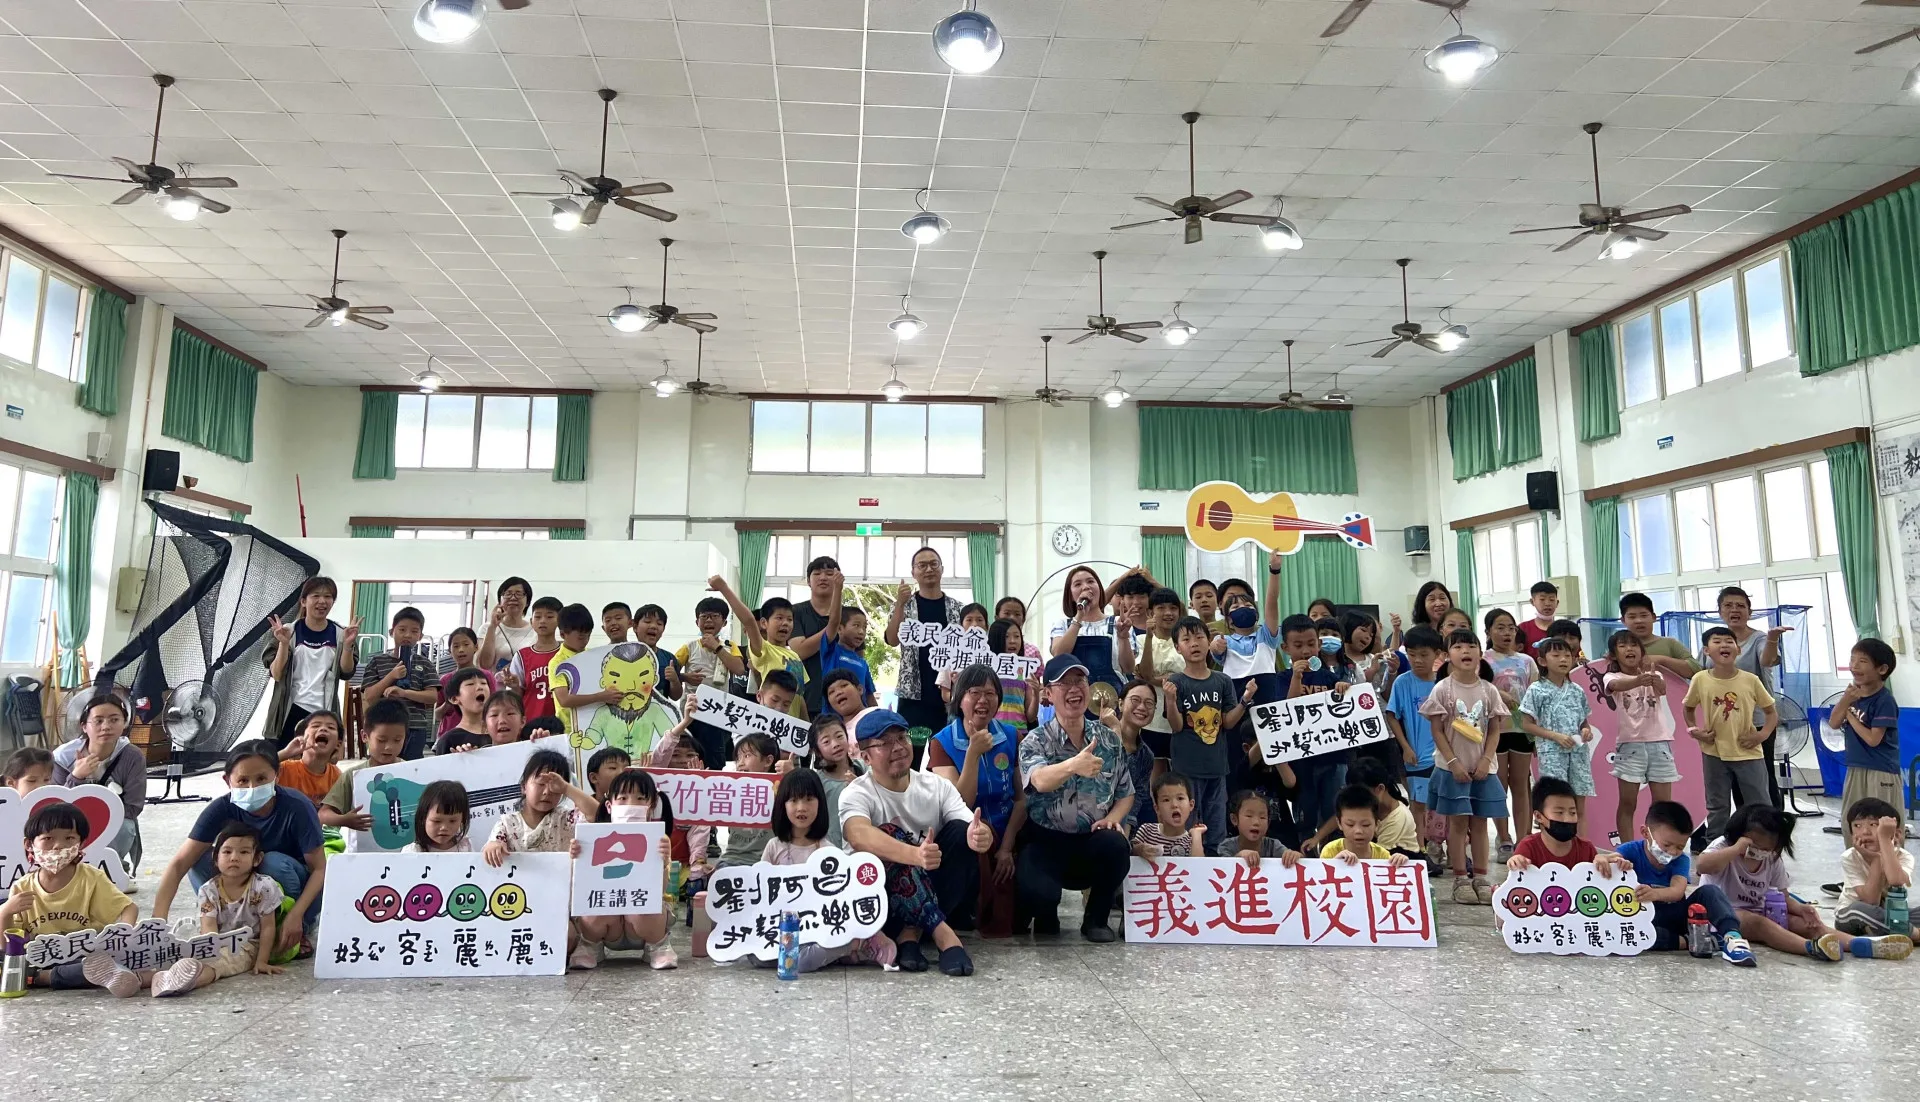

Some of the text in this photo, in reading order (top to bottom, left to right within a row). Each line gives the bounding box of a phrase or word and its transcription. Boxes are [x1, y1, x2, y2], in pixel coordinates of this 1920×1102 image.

[1183, 691, 1222, 710] SIMB
[859, 864, 878, 883] 與
[1126, 861, 1430, 943] 義進校園
[47, 911, 90, 927] EXPLORE
[110, 929, 249, 971] 捱轉屋下
